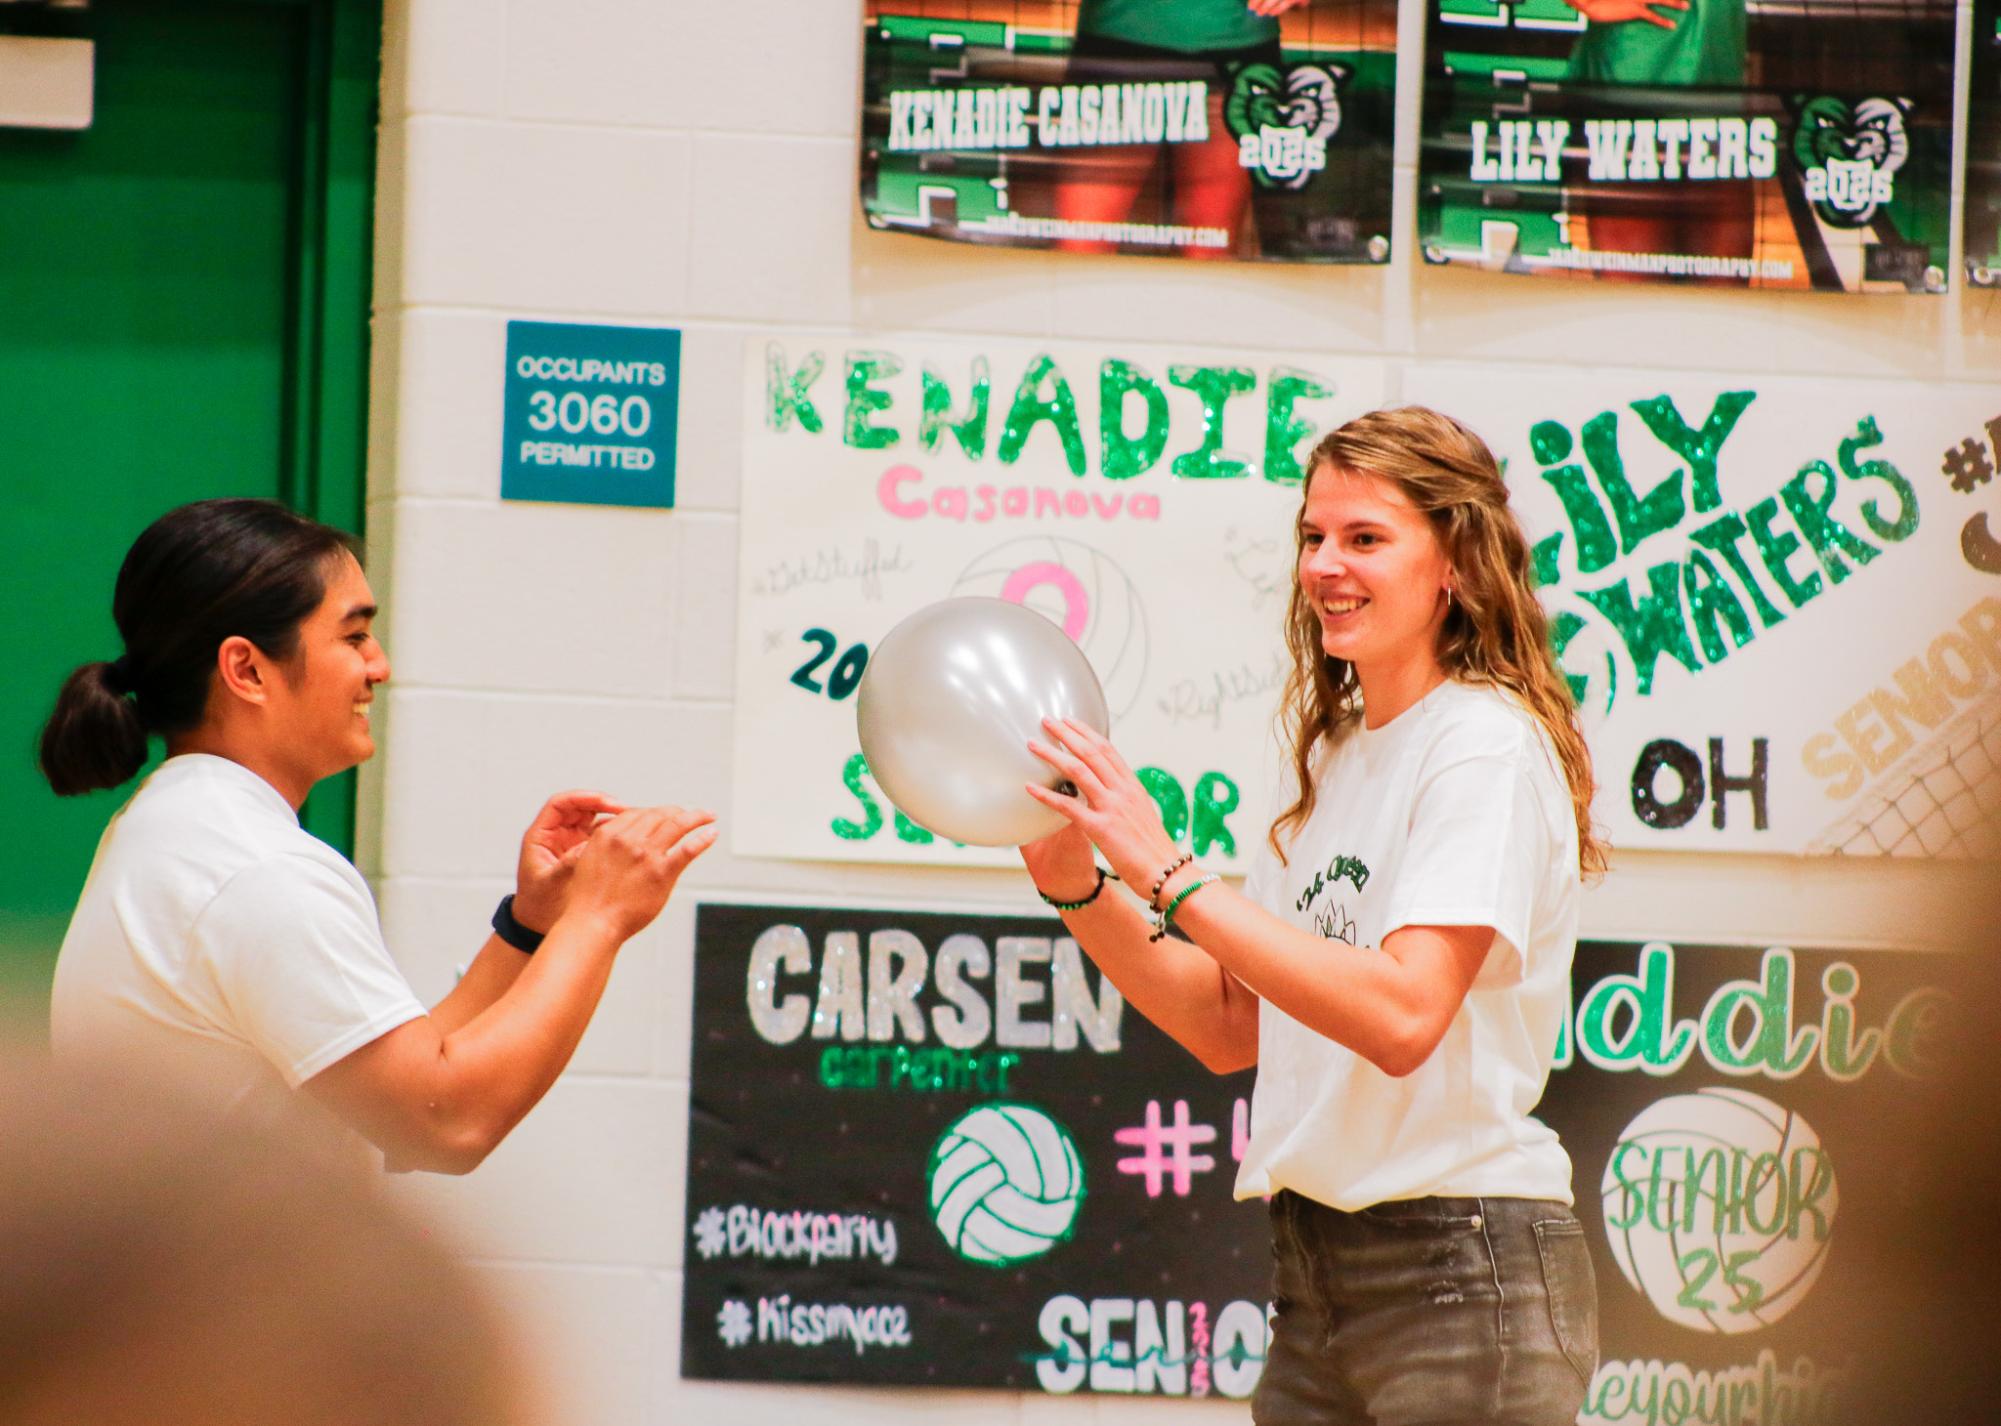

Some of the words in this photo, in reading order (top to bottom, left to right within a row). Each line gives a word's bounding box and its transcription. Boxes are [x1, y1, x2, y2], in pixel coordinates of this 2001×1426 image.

[888, 87, 1030, 150] KENADIE
[1038, 81, 1210, 147] CASANOVA
[1469, 119, 1570, 182] LILY
[1584, 117, 1778, 180] WATERS
[516, 354, 666, 387] OCCUPANTS
[528, 393, 652, 438] 3060
[764, 340, 1335, 487] KENADIE
[519, 441, 656, 472] PERMITTED
[876, 462, 1163, 523] Casanova
[1573, 414, 1920, 697] WATERS
[1631, 737, 1769, 831] OH
[747, 923, 1124, 1053] CARSEN
[1608, 1138, 1832, 1242] SENIOR
[1676, 1246, 1763, 1314] 25
